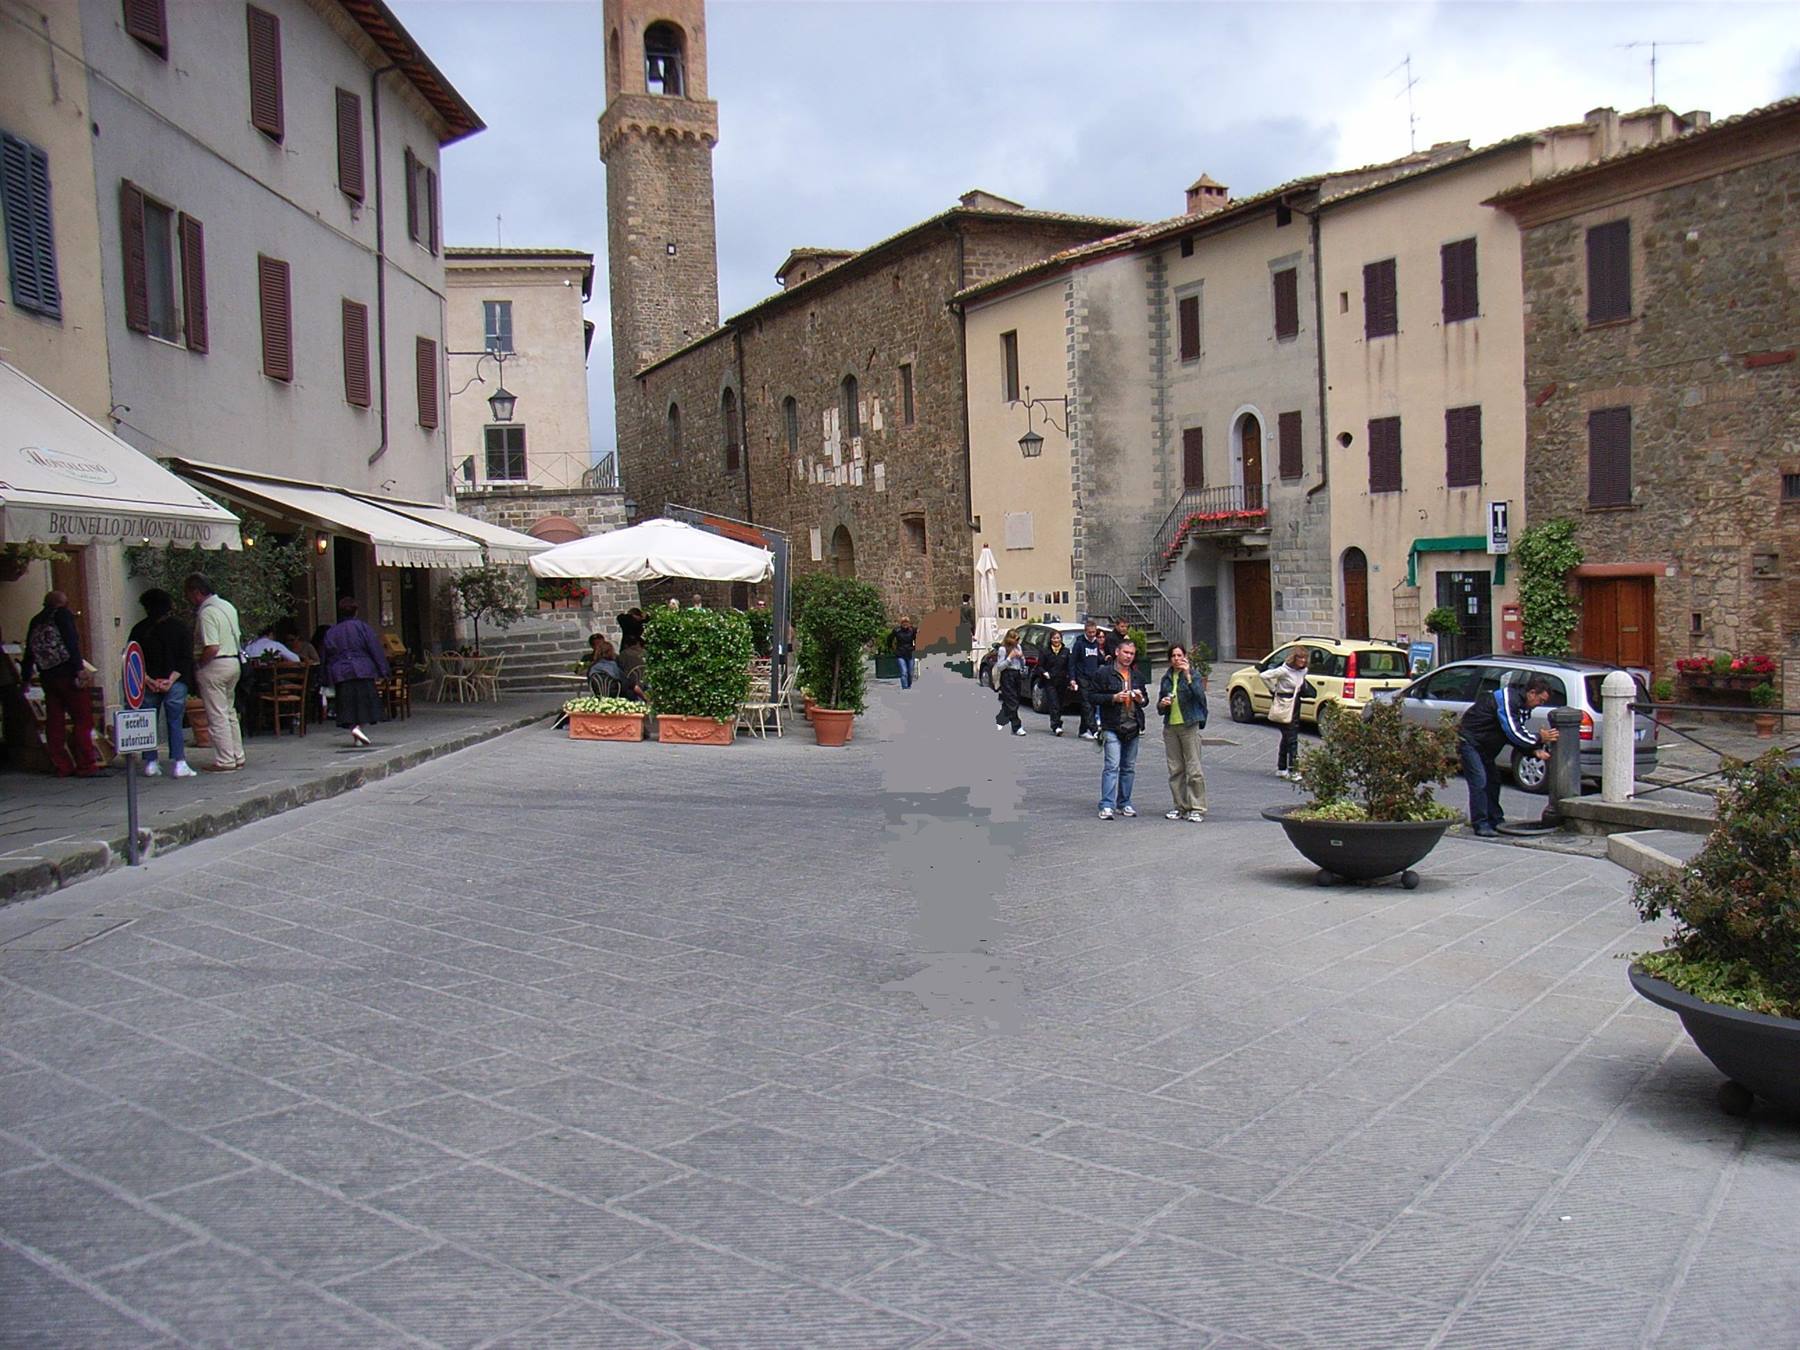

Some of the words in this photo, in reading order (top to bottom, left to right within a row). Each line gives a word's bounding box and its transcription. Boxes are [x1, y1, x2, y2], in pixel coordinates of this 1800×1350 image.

[49, 512, 120, 536] BRUNELLO
[122, 518, 136, 536] DI
[136, 517, 211, 540] MONTALCINO
[126, 717, 149, 729] eccetto
